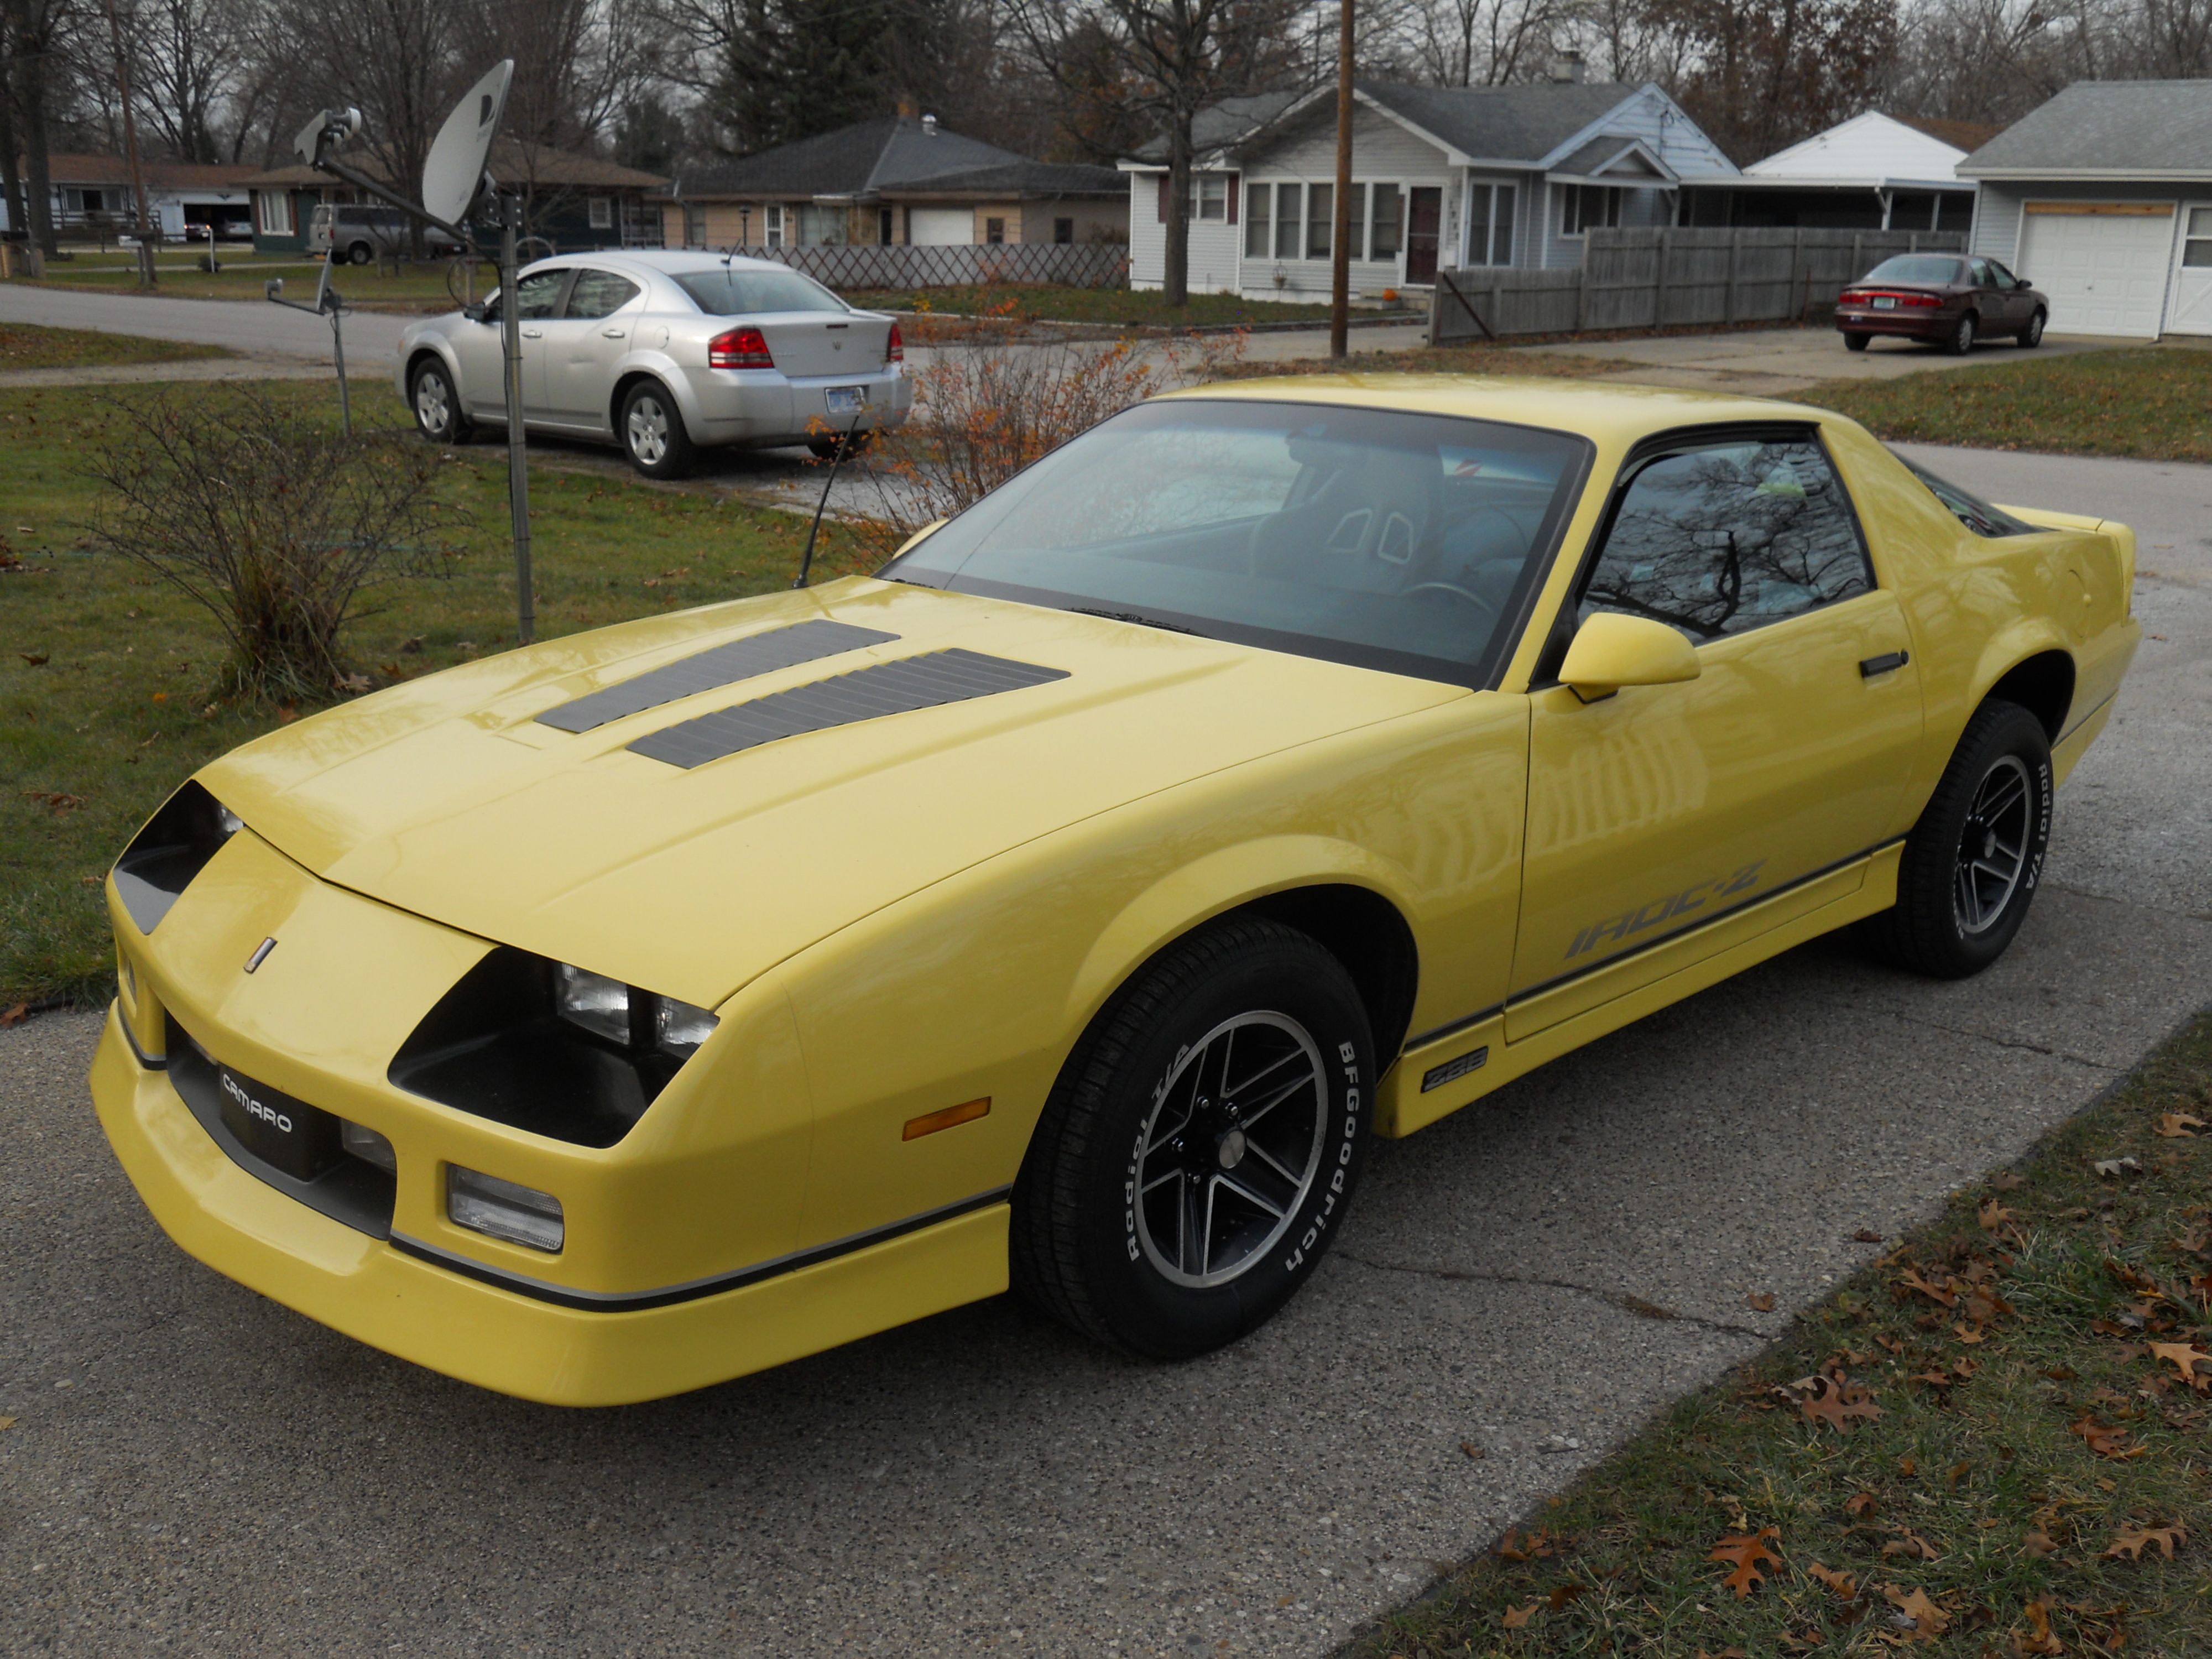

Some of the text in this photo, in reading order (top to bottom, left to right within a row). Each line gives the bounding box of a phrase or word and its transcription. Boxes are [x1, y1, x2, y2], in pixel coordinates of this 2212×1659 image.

[2025, 763, 2049, 889] Radial T/A
[1564, 858, 1768, 960] IROC-Z
[223, 1073, 292, 1133] CAMARO
[1283, 1041, 1360, 1271] BFGoodrich
[1125, 1119, 1147, 1261] Radial
